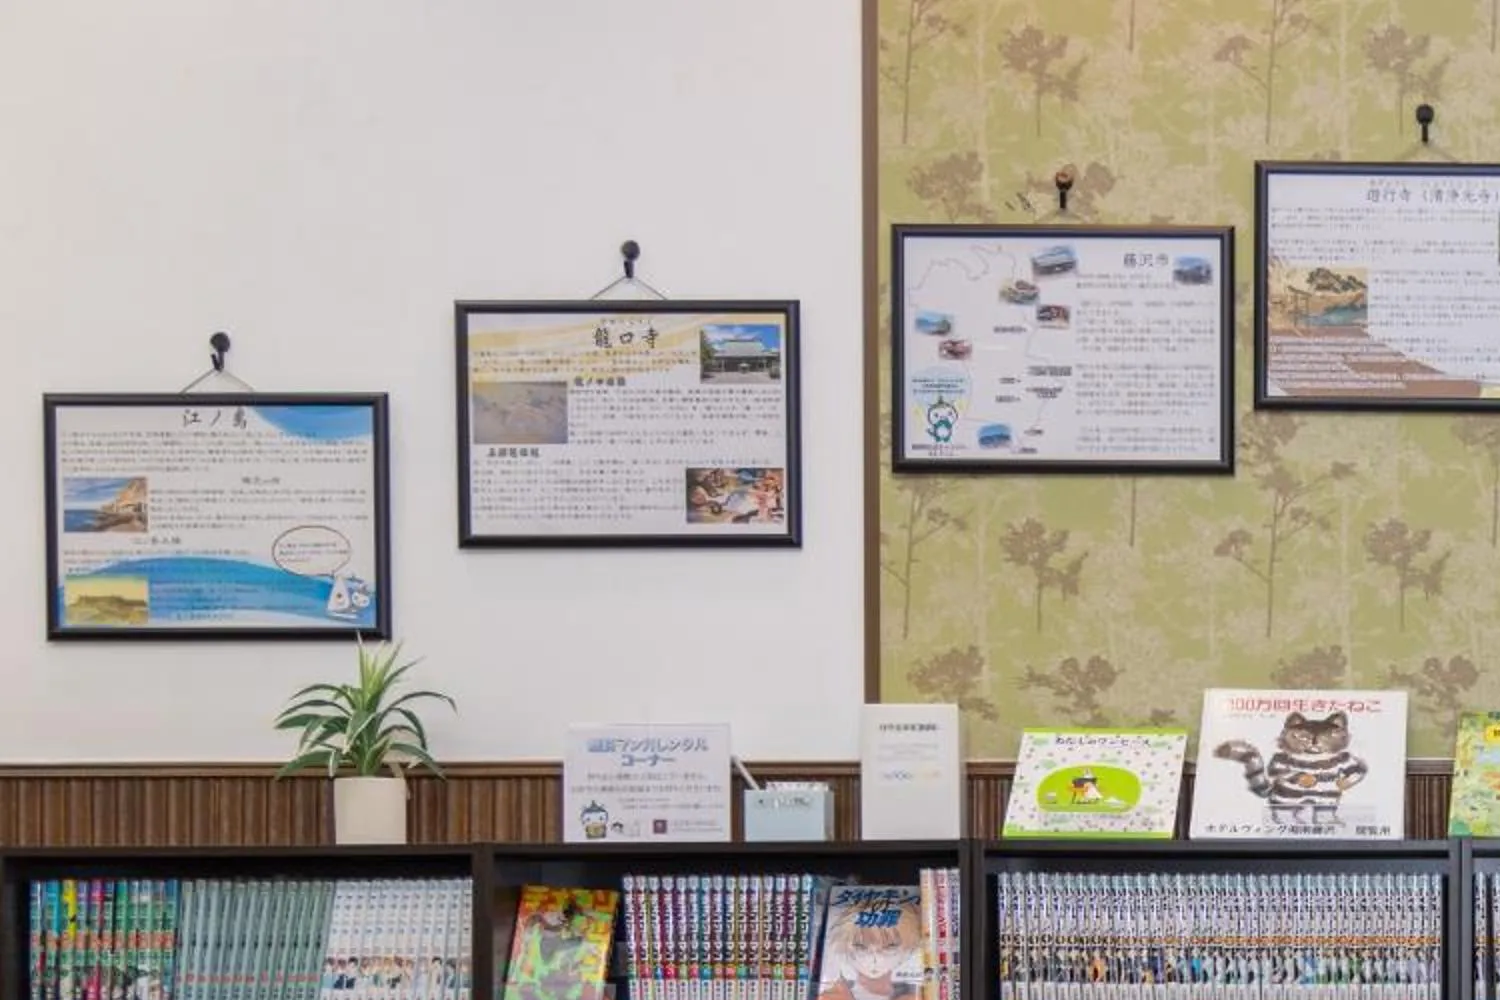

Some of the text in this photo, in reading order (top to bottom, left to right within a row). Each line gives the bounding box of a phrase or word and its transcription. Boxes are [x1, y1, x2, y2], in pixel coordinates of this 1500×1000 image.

[594, 327, 658, 349] 龍口寺
[183, 406, 247, 429] 江ノ島
[621, 755, 676, 767] コーナー
